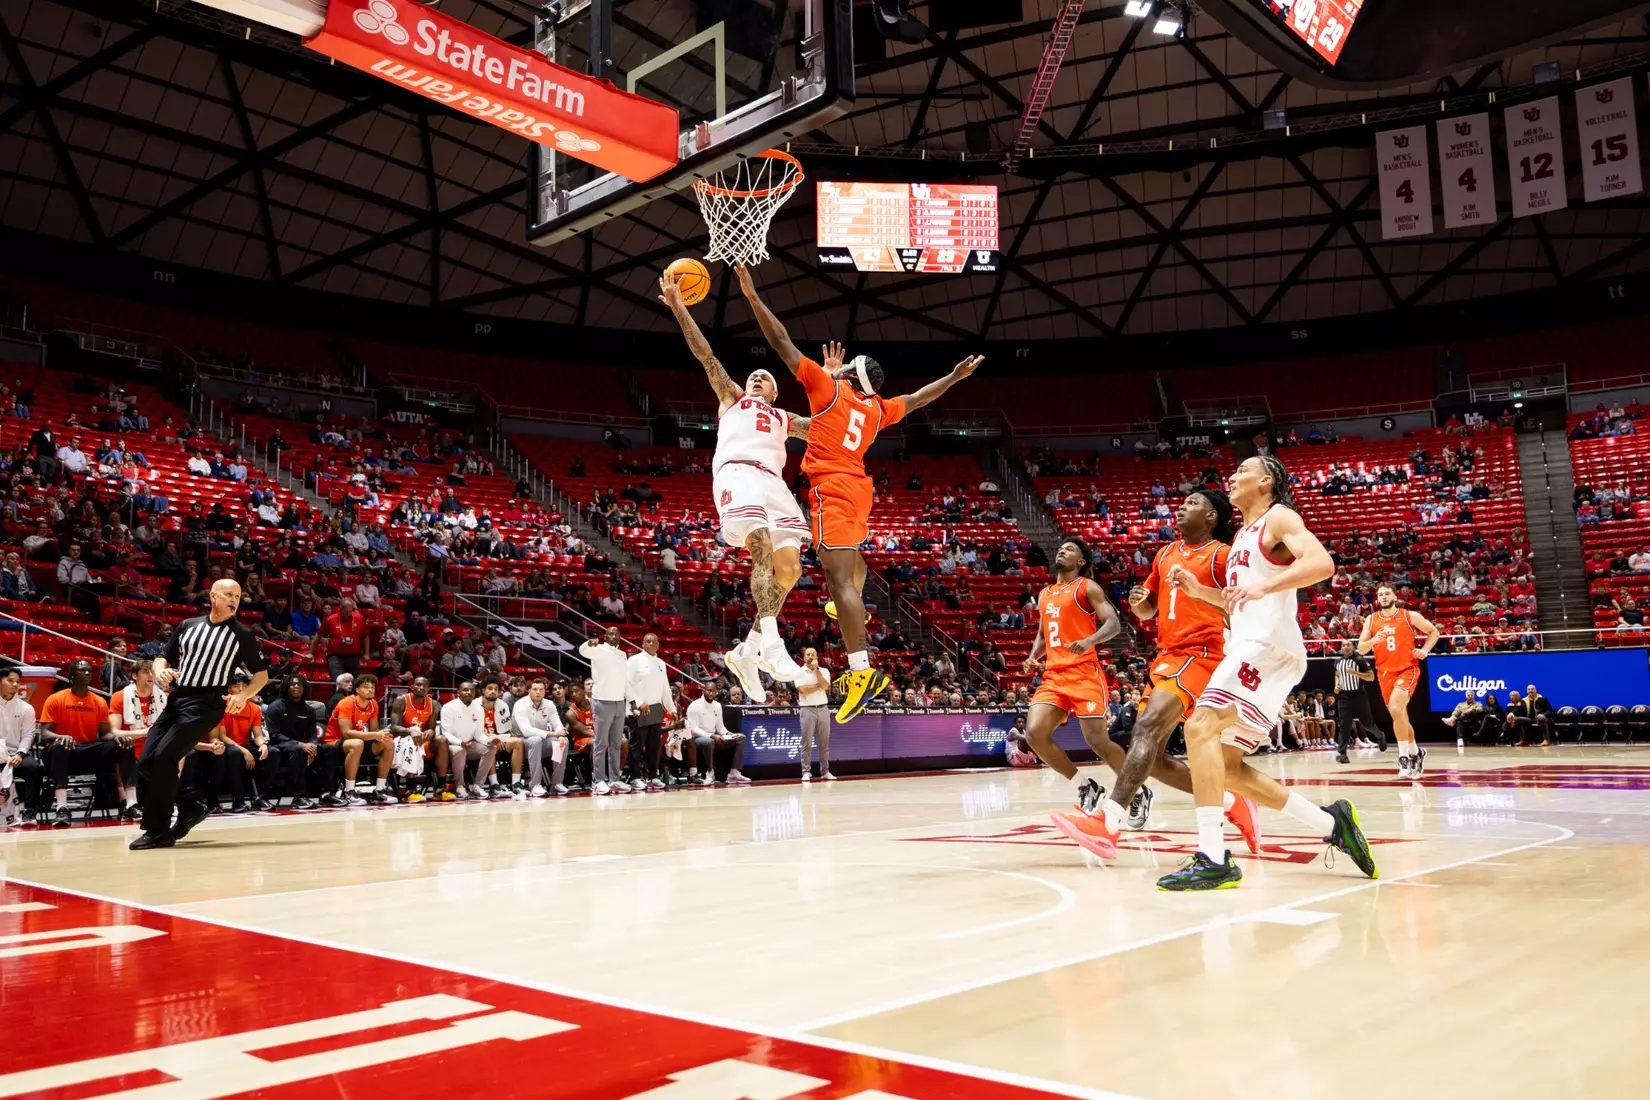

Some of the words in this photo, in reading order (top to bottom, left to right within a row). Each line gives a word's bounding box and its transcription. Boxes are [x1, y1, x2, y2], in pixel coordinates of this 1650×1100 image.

[1318, 16, 1345, 52] 29
[1585, 110, 1628, 126] VOLLEYBALL
[1523, 127, 1544, 137] MEN'S
[1513, 132, 1555, 147] BASKETBALL
[1450, 141, 1479, 151] WOMEN'S
[1591, 133, 1628, 166] 15
[1393, 153, 1412, 161] MEN'S
[1445, 148, 1484, 160] BASKETBALL
[1384, 160, 1422, 171] BASKETBALL
[1520, 152, 1554, 183] 12
[1458, 168, 1477, 192] 4
[1605, 174, 1619, 182] KIM
[1396, 179, 1414, 204] 4
[1600, 181, 1626, 192] TURNER
[1530, 190, 1548, 200] BILLY
[1394, 214, 1420, 224] ANDREW
[1460, 212, 1480, 220] SMITH
[153, 270, 174, 284] nn
[1608, 284, 1625, 300] tt
[475, 323, 491, 335] pp
[751, 346, 766, 358] qq
[1016, 348, 1029, 358] rr
[322, 400, 331, 411] N
[756, 412, 771, 433] 2
[1383, 420, 1392, 429] S
[605, 431, 612, 440] P
[842, 408, 866, 451] 5
[1112, 438, 1121, 447] R
[1167, 587, 1178, 620] 1
[1048, 621, 1062, 648] 2
[1386, 635, 1396, 652] 8
[1437, 674, 1505, 697] Culligan
